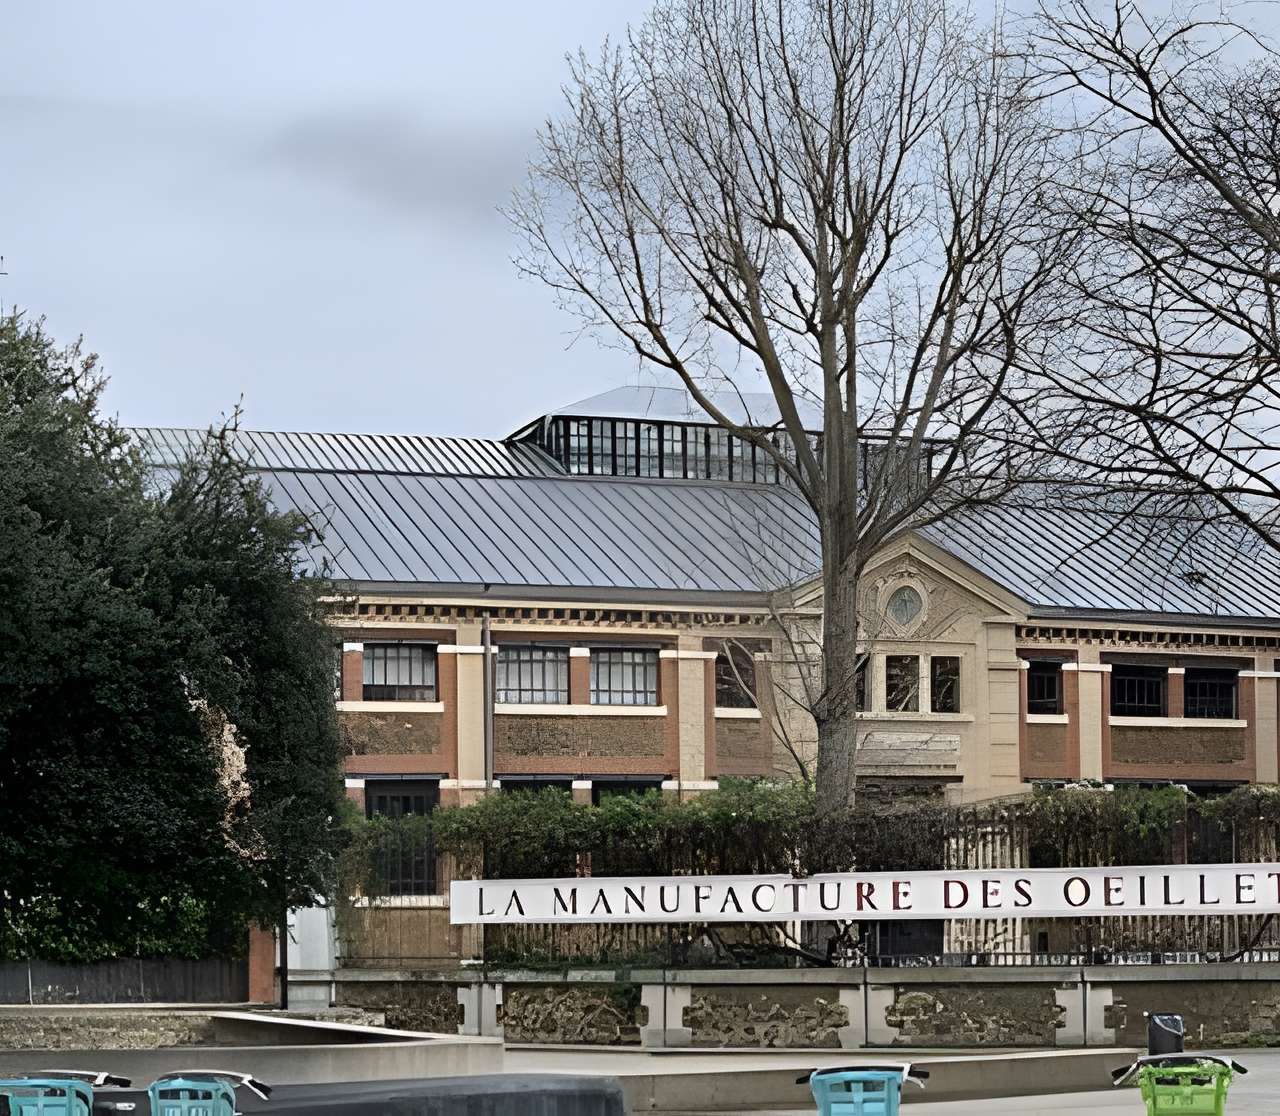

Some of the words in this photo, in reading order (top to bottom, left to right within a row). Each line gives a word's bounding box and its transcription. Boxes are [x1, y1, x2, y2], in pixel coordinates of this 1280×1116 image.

[478, 887, 526, 916] LA
[553, 880, 913, 915] MANUFACTURE
[943, 878, 1033, 909] DES
